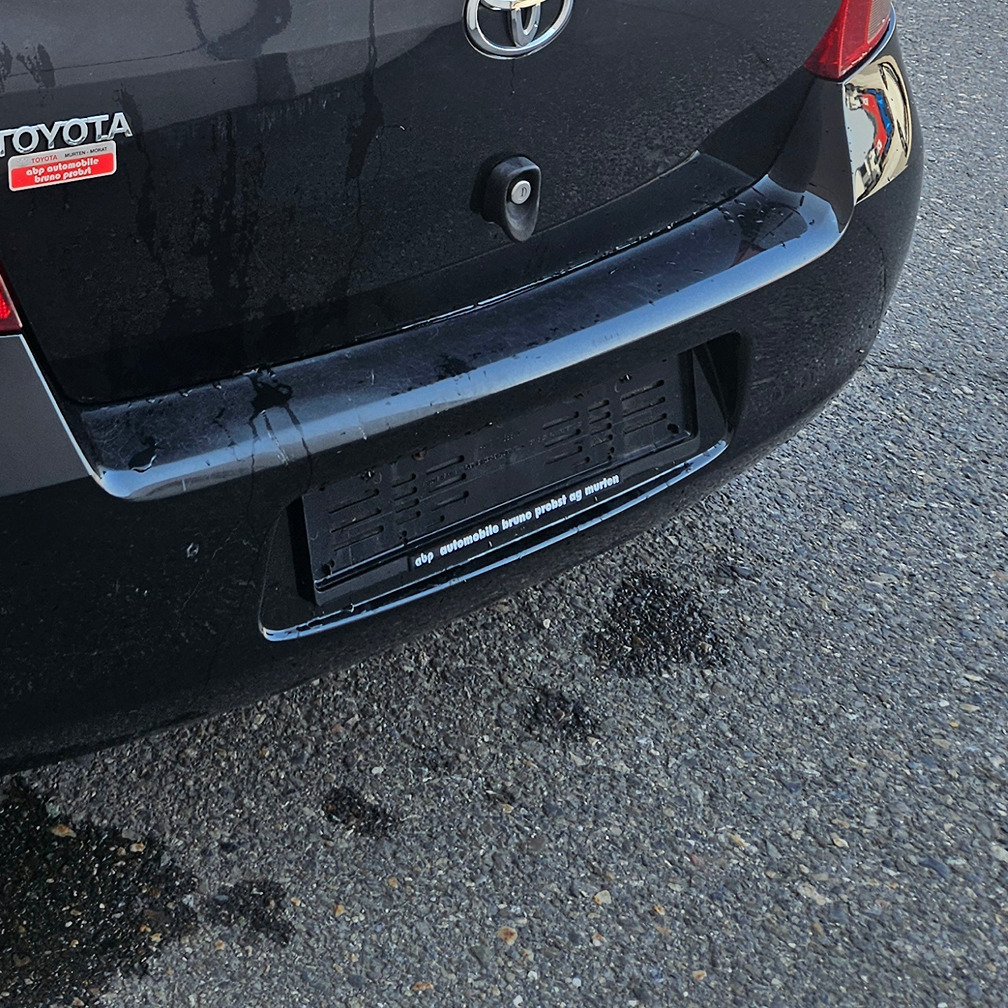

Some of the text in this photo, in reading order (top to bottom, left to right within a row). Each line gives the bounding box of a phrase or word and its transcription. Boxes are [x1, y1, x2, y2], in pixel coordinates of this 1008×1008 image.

[32, 154, 58, 164] TOYOTA
[64, 150, 86, 159] MURTEN
[90, 147, 108, 155] MORAT
[26, 158, 100, 177] abp automobile
[34, 168, 92, 184] bruno probst
[415, 474, 620, 568] abp automobile bruno probst ag murten
